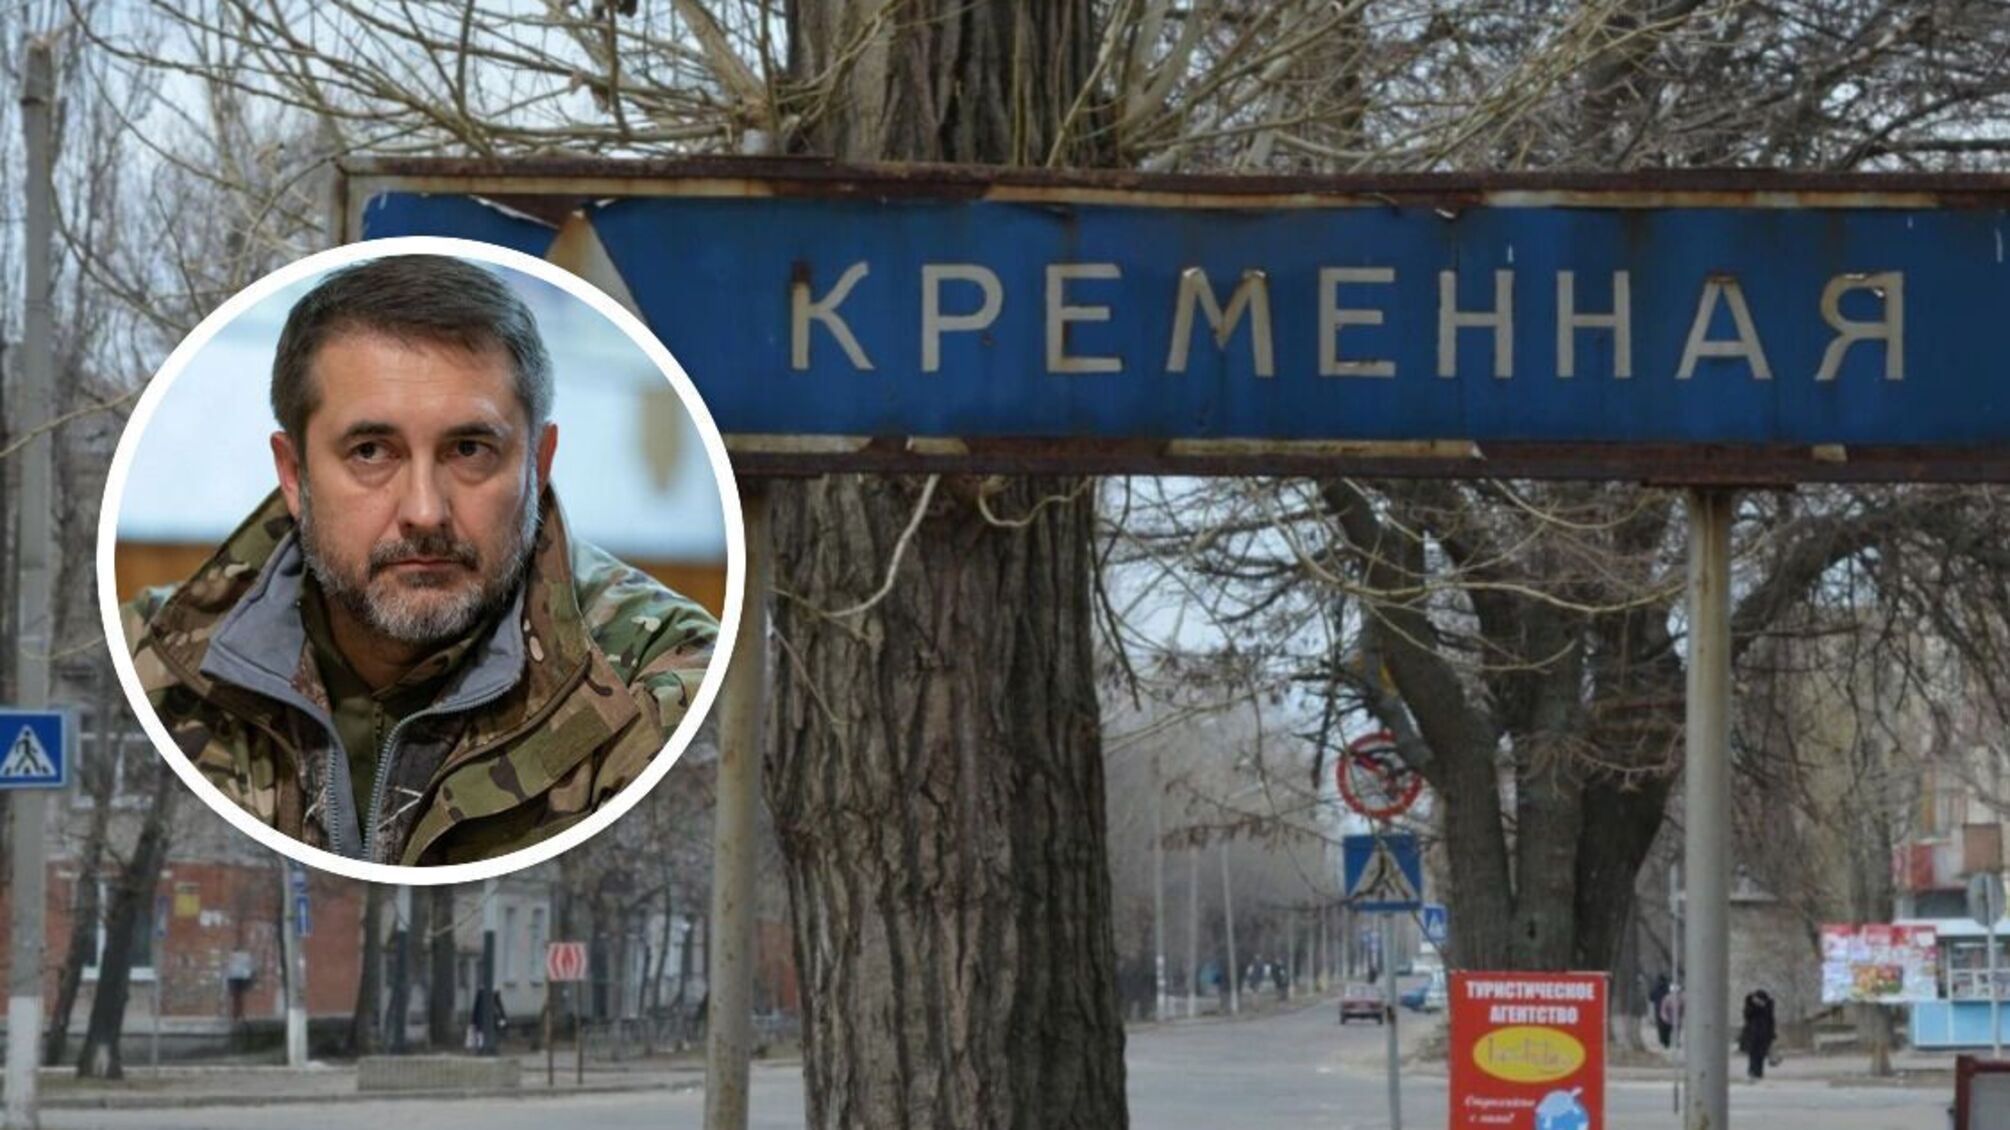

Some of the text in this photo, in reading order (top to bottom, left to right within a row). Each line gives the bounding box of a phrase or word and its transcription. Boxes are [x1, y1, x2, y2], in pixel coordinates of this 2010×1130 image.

[790, 261, 1905, 381] КРЕМЕННАЯ
[1466, 980, 1595, 1000] ТУРИСТИЧЕСКОЕ
[1489, 1005, 1579, 1023] АГЕНТСТВО
